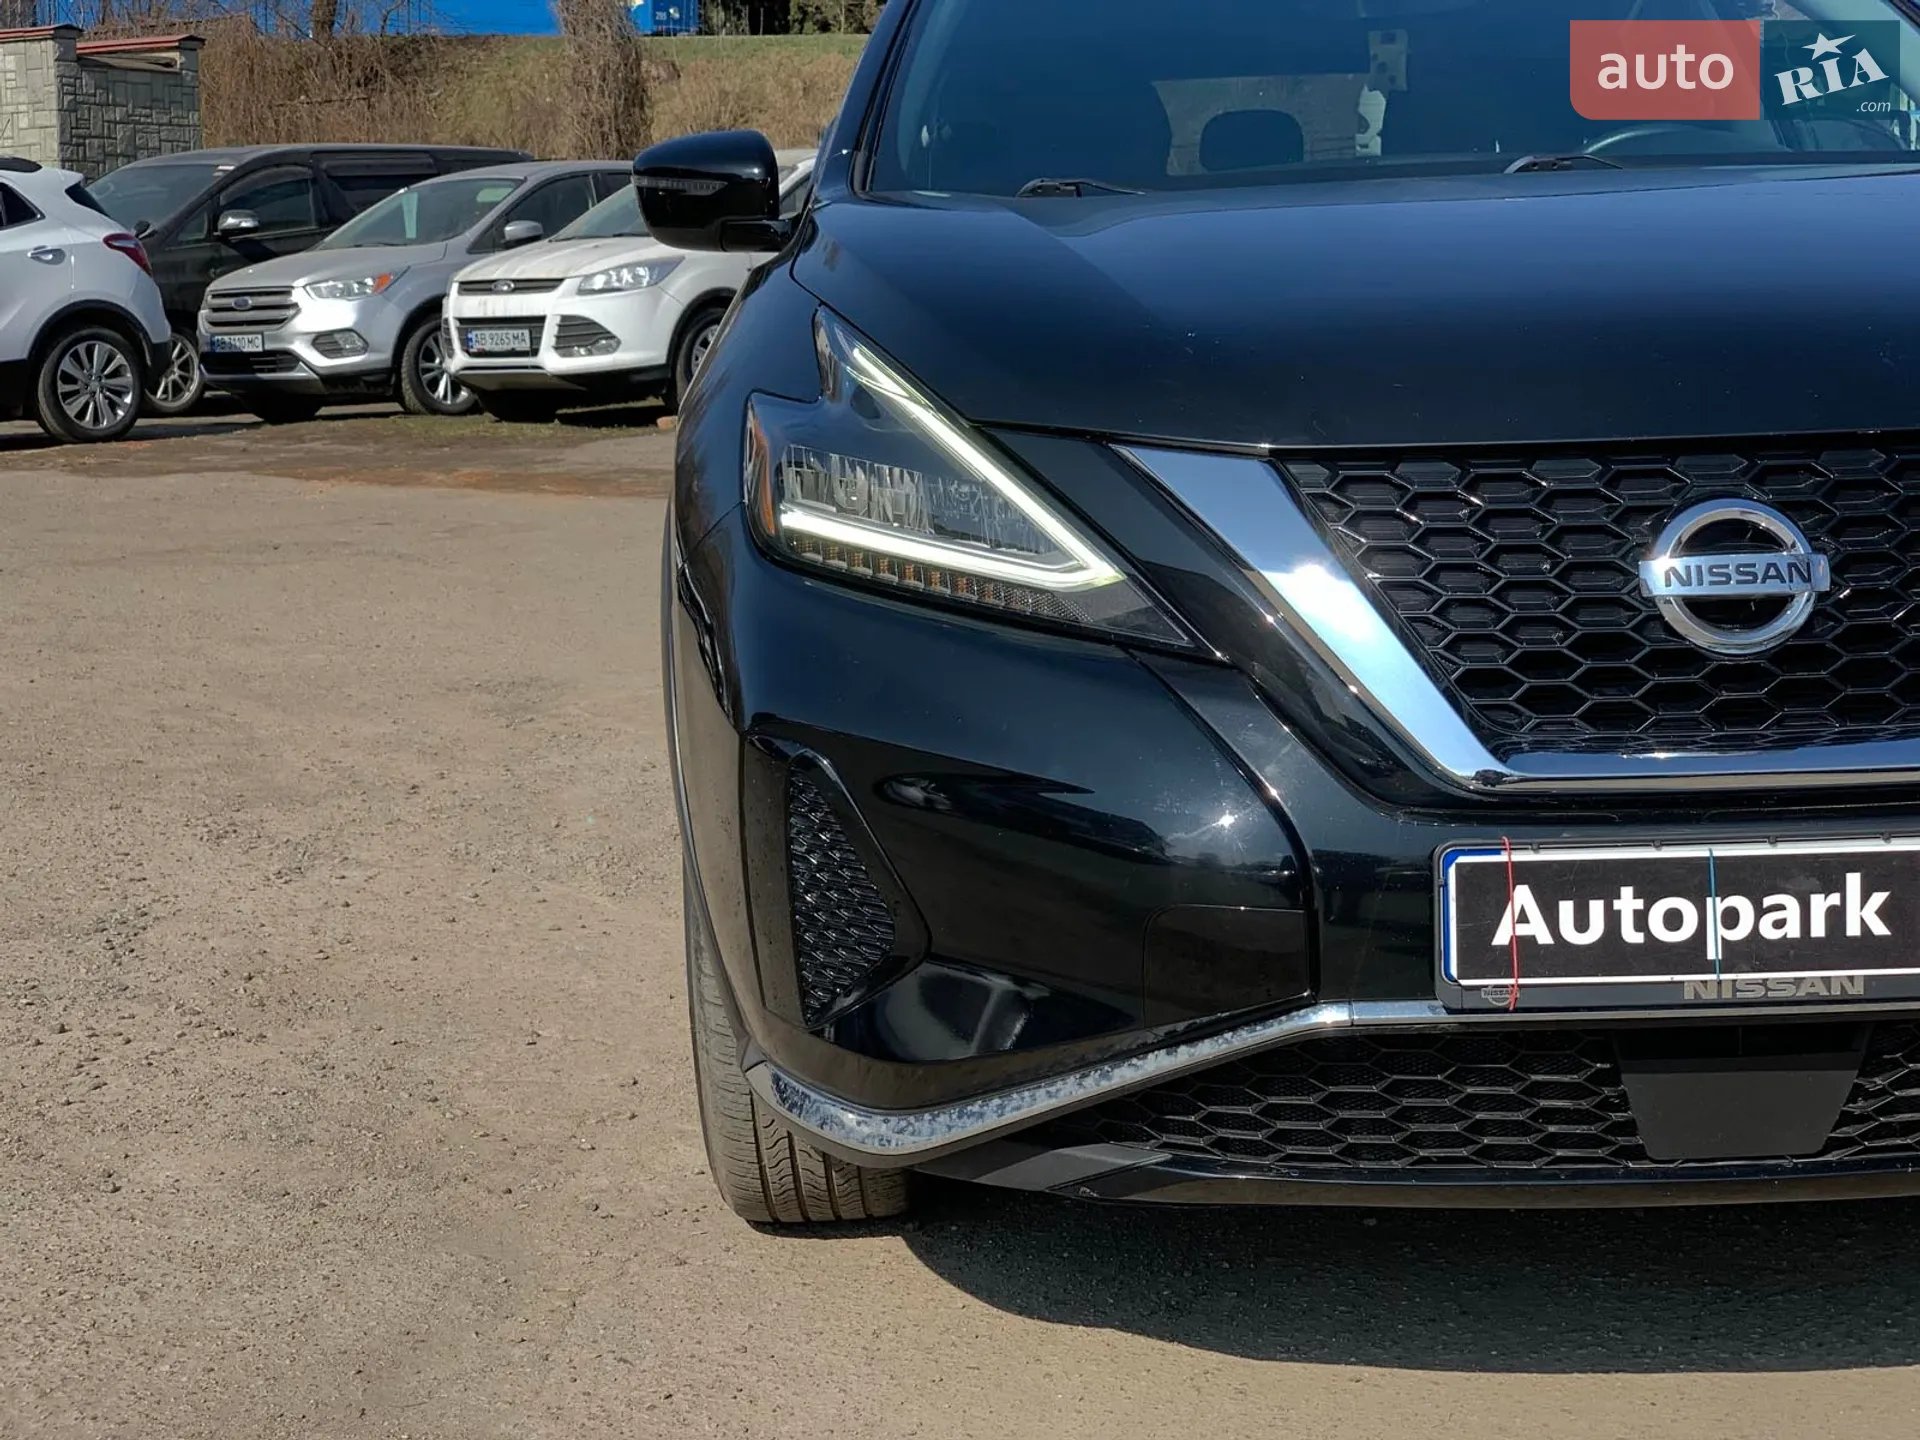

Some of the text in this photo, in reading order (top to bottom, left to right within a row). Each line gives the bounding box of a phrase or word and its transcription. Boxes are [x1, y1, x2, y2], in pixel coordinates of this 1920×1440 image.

[247, 336, 260, 349] MC
[475, 332, 528, 346] AB 9265 MA
[1664, 562, 1811, 587] NISSAN
[1491, 872, 1892, 960] Autopark
[1683, 975, 1865, 1000] NISSAN
